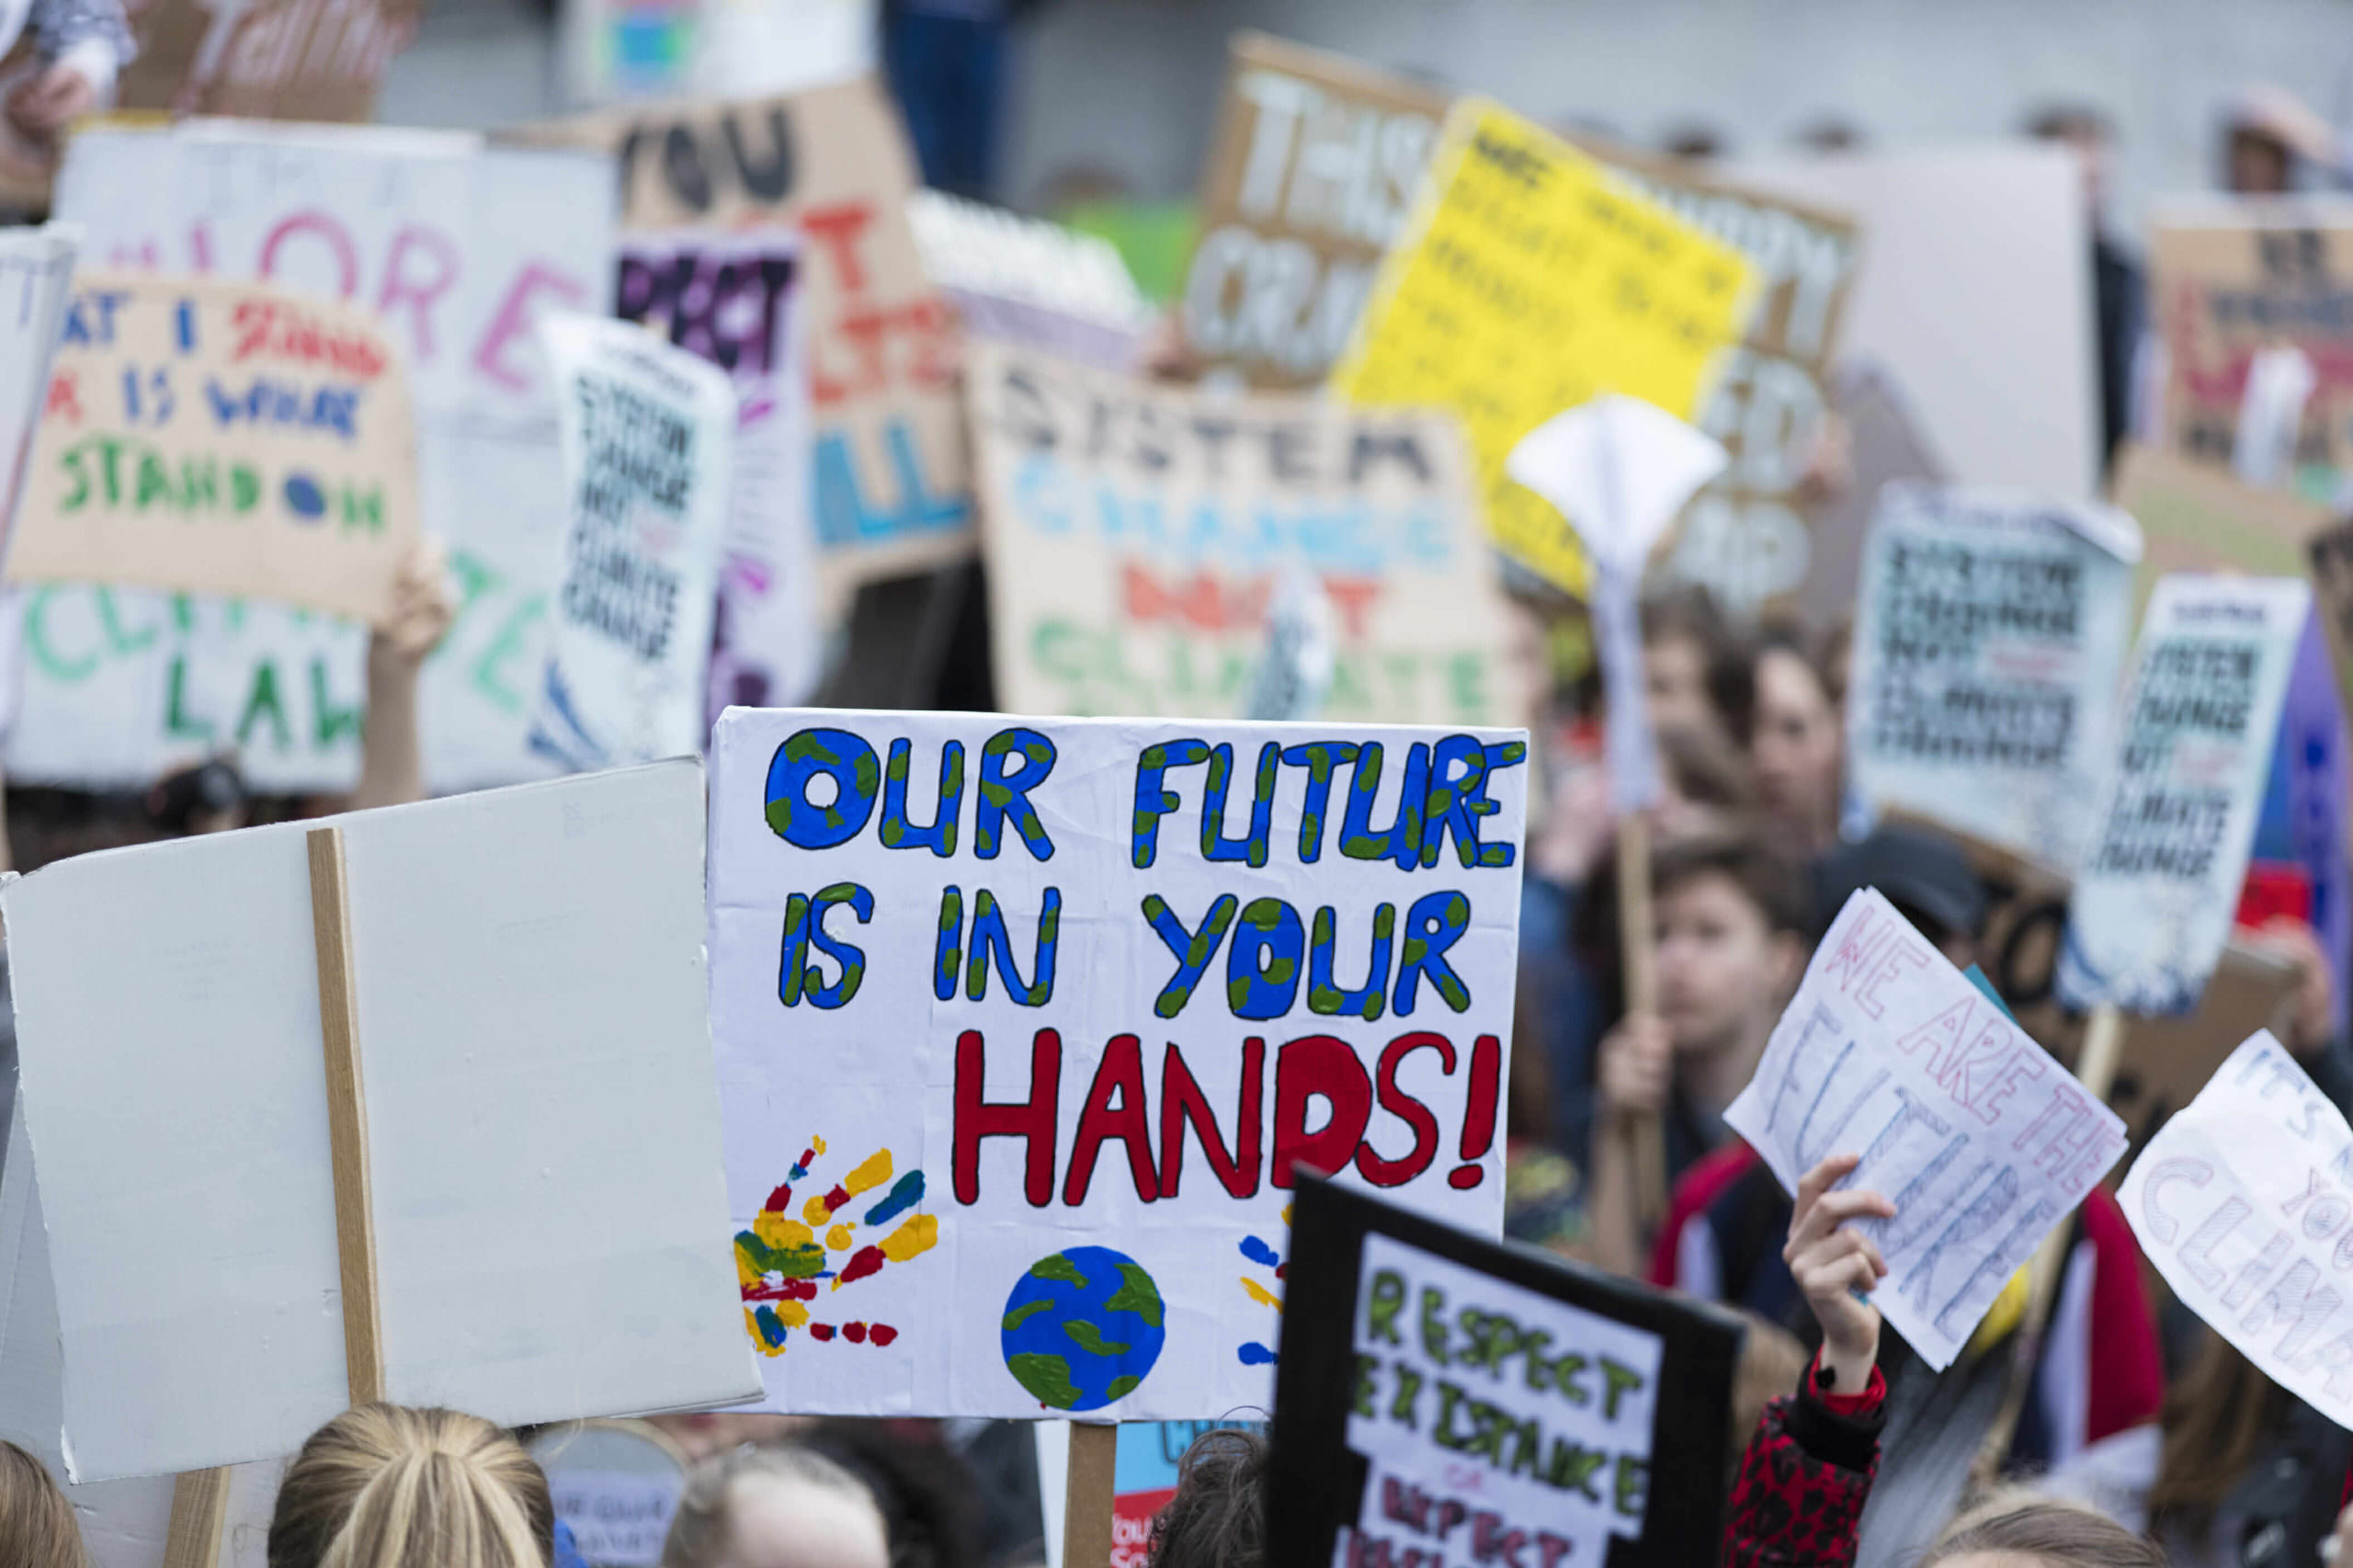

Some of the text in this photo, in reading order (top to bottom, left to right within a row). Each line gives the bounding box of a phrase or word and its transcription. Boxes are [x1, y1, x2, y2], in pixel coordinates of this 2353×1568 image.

[765, 727, 1527, 871] OUR FUTURE
[778, 881, 1472, 1021] IS IN YOUR
[951, 1027, 1502, 1208] HANDS!
[1825, 903, 1931, 1021] WE
[1897, 995, 2048, 1127] ARE
[2011, 1082, 2125, 1195] THE
[1765, 1004, 2059, 1345] FUTURE
[1369, 1269, 1643, 1422] RESPECT
